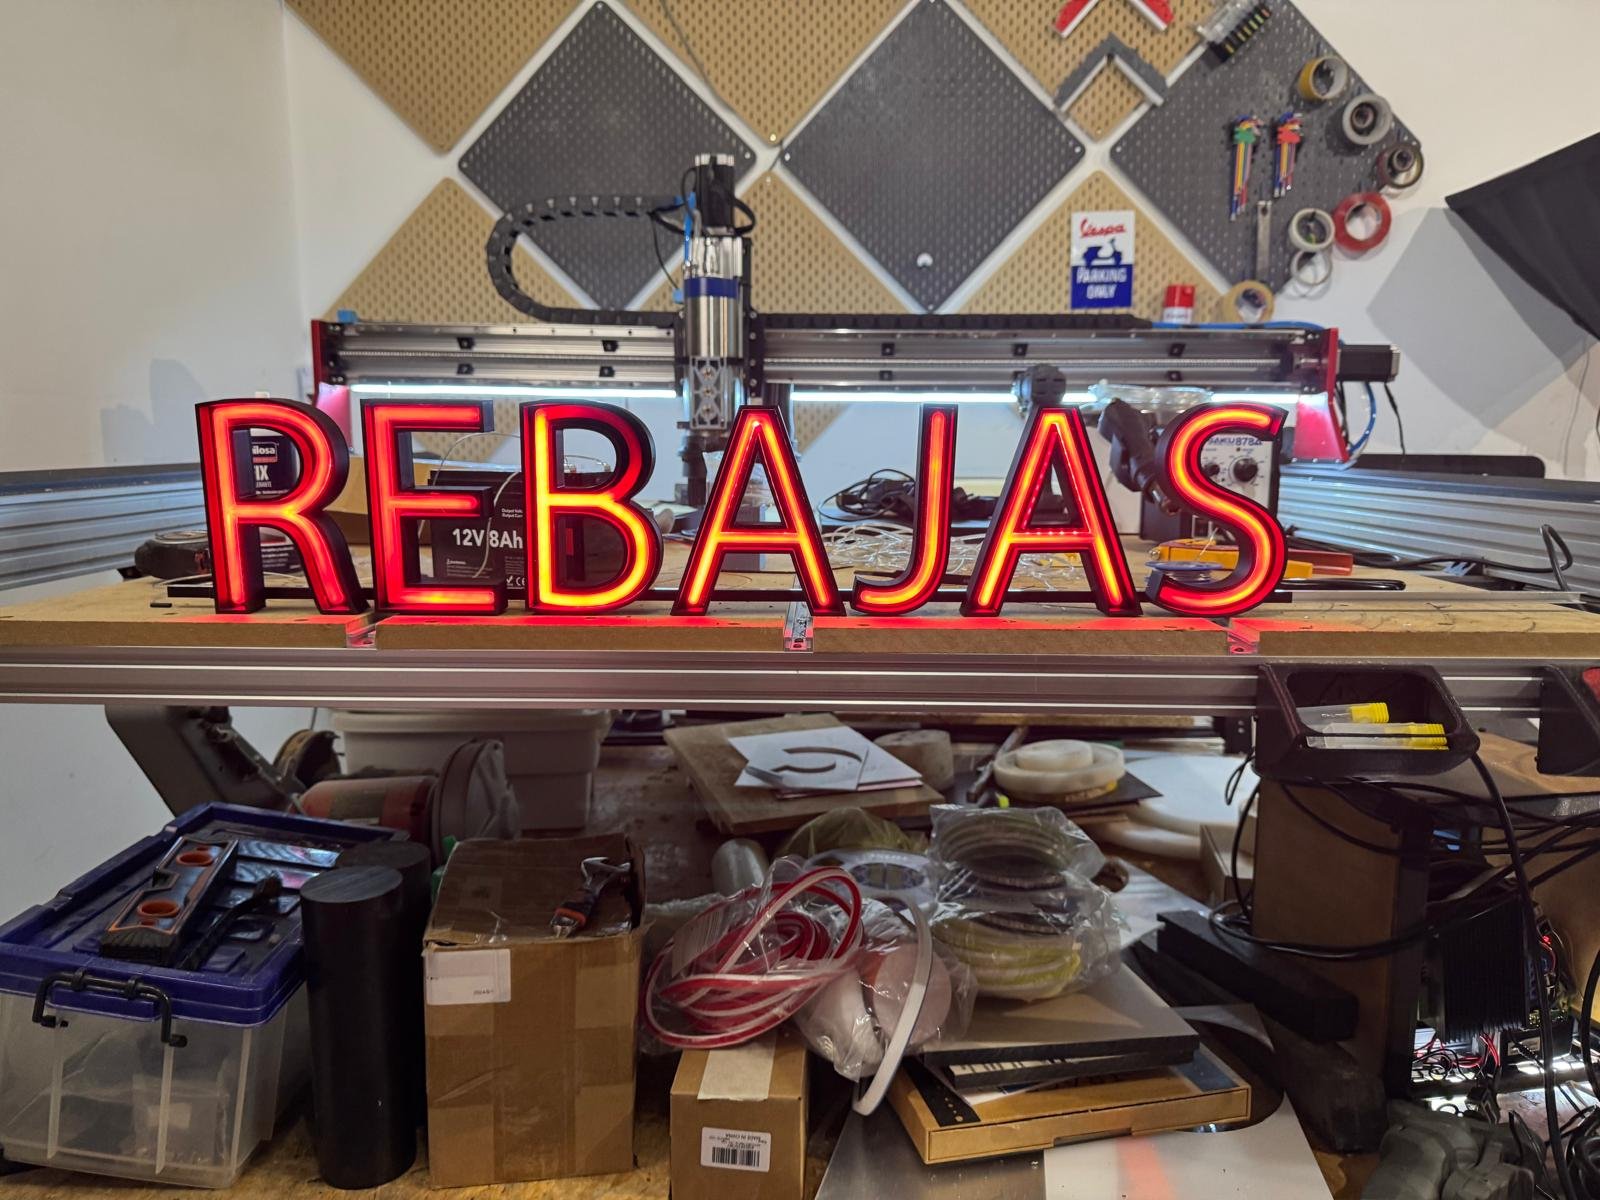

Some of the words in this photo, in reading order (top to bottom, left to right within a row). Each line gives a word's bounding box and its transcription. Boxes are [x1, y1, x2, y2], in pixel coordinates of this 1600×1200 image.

[1080, 218, 1126, 238] Vespa
[1076, 266, 1128, 284] PARKING
[1086, 283, 1117, 299] ONLY
[251, 445, 276, 455] ilosa
[254, 464, 269, 481] IX
[195, 398, 1288, 617] REBAJAS
[452, 528, 485, 547] 12V
[489, 530, 523, 549] 8Ah
